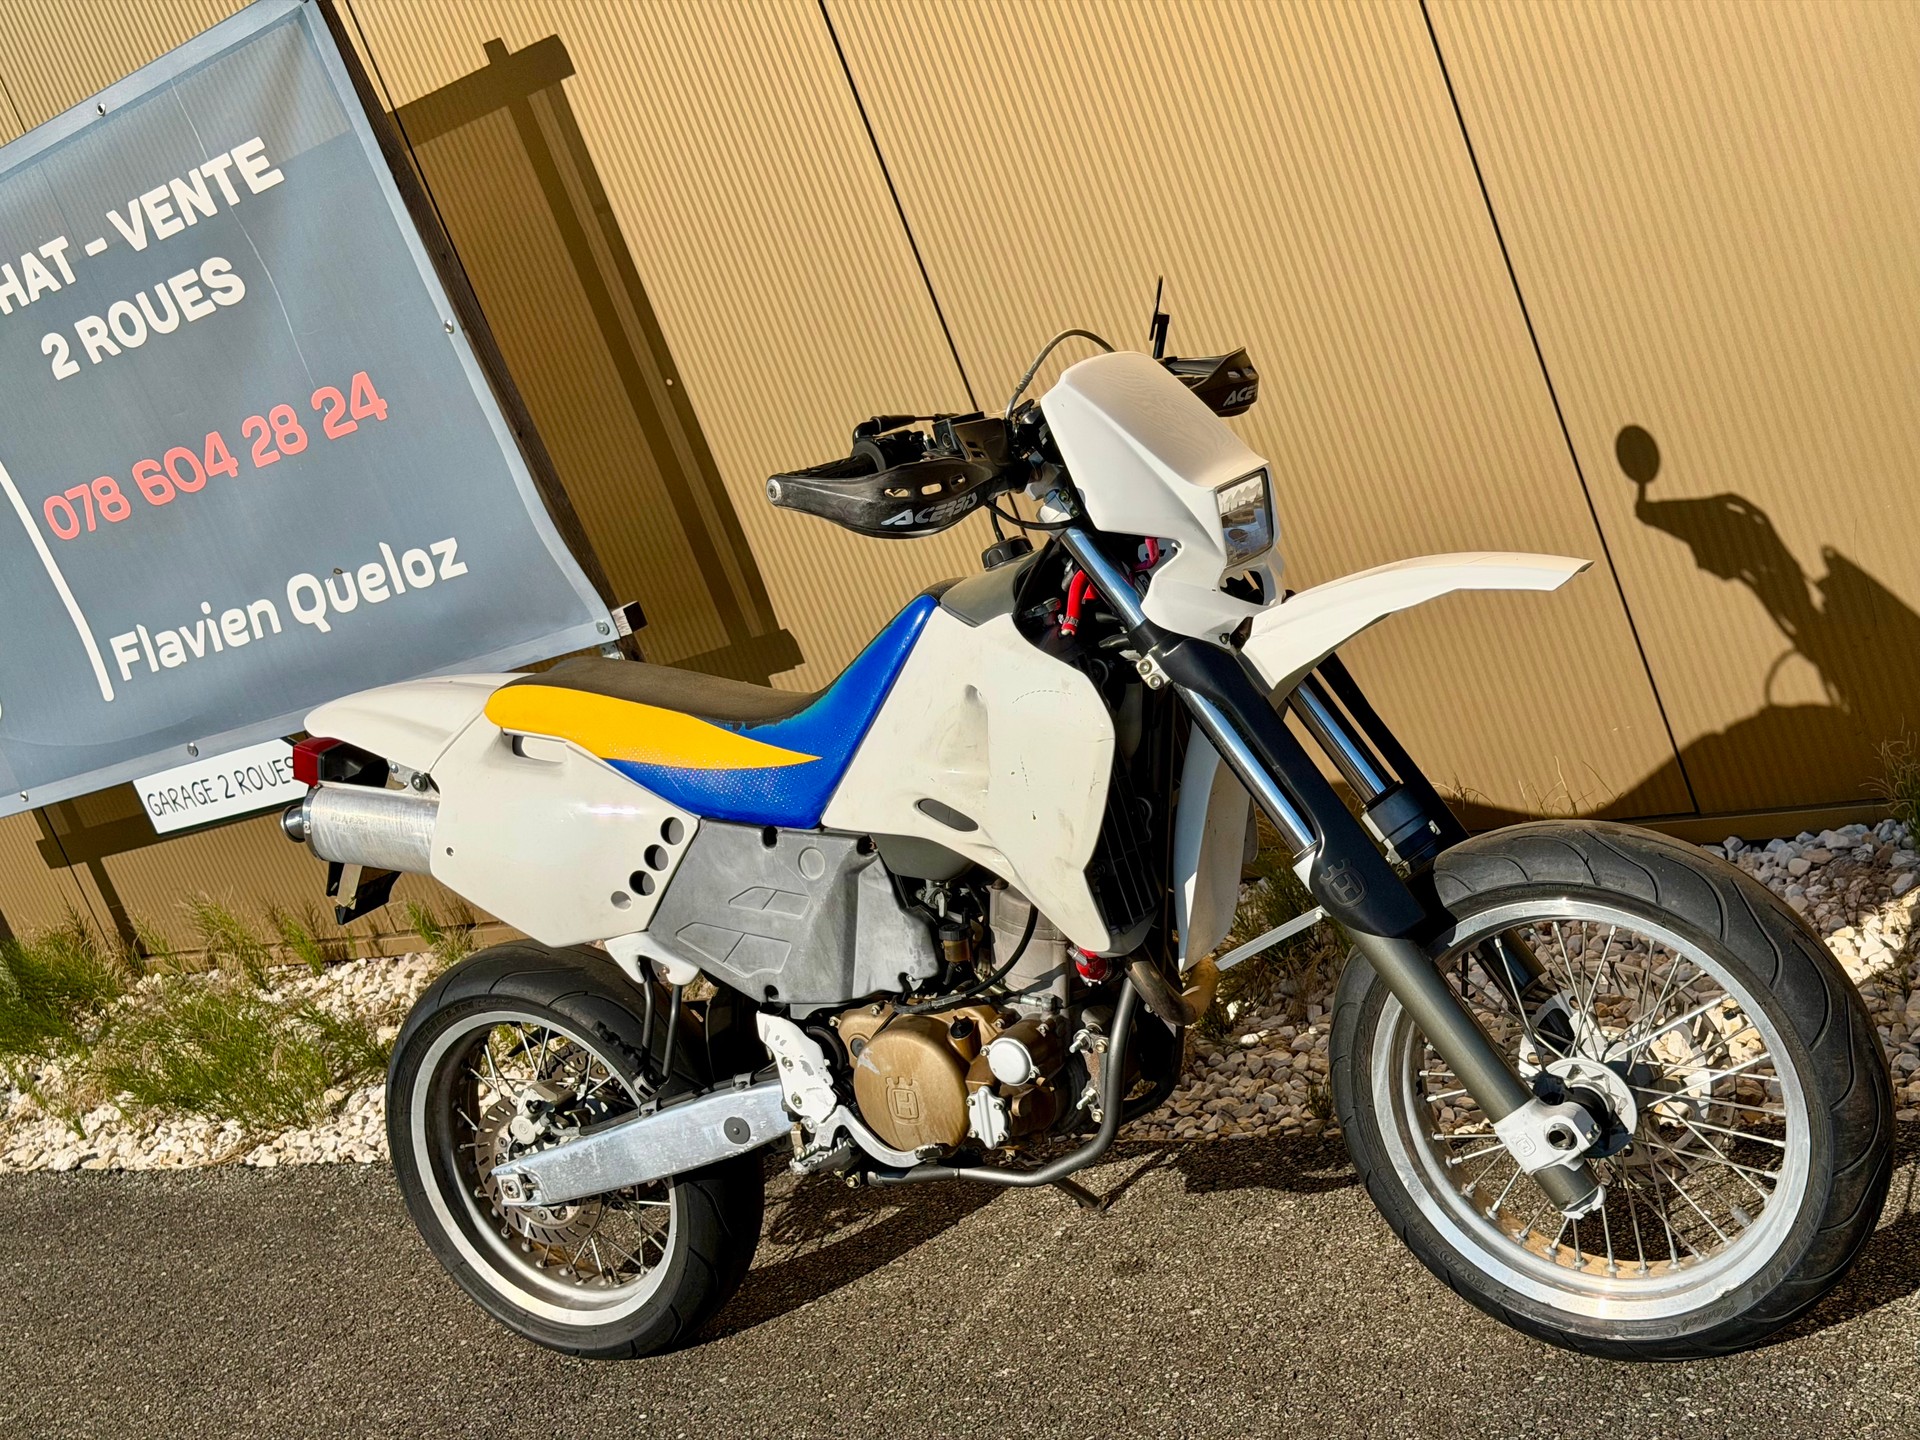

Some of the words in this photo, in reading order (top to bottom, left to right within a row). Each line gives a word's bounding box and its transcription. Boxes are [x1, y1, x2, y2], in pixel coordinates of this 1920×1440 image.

[105, 136, 285, 252] VENTE
[40, 332, 81, 381] 2
[74, 257, 246, 364] ROUES
[43, 476, 132, 540] 078
[131, 431, 239, 506] 604
[241, 404, 308, 468] 28
[310, 371, 388, 440] 24
[109, 599, 282, 681] Flavien
[286, 537, 469, 633] Queloz
[146, 777, 218, 818] GARAGE
[217, 774, 236, 800] 2
